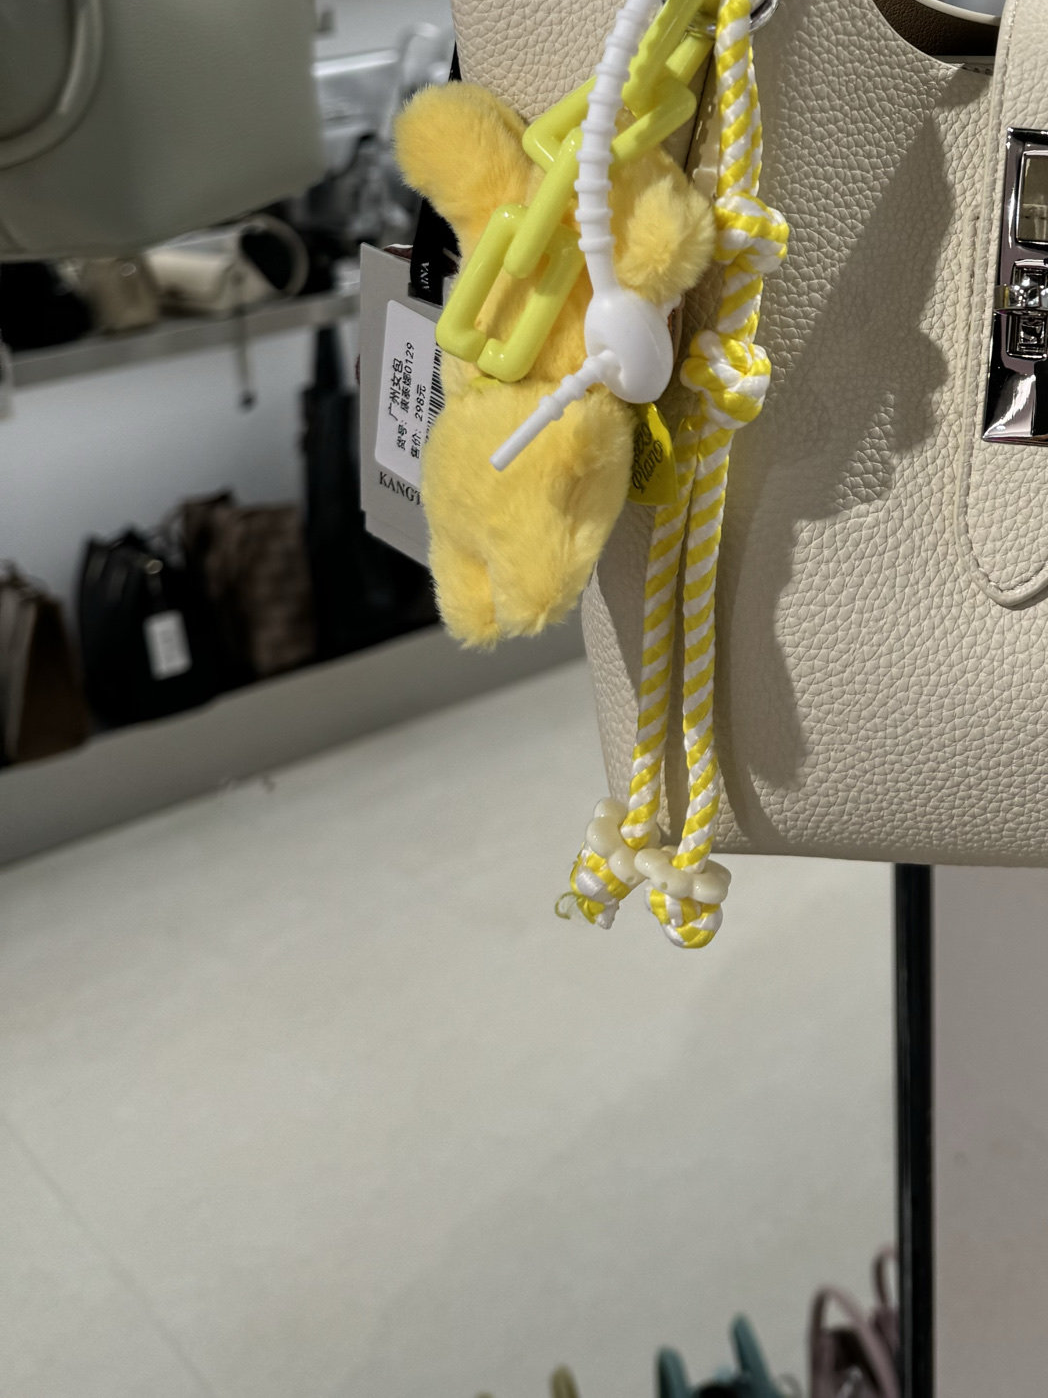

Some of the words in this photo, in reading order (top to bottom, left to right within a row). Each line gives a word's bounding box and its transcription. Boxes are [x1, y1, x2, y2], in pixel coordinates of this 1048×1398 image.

[387, 358, 403, 421] 广州女包
[379, 471, 424, 506] KANGT
